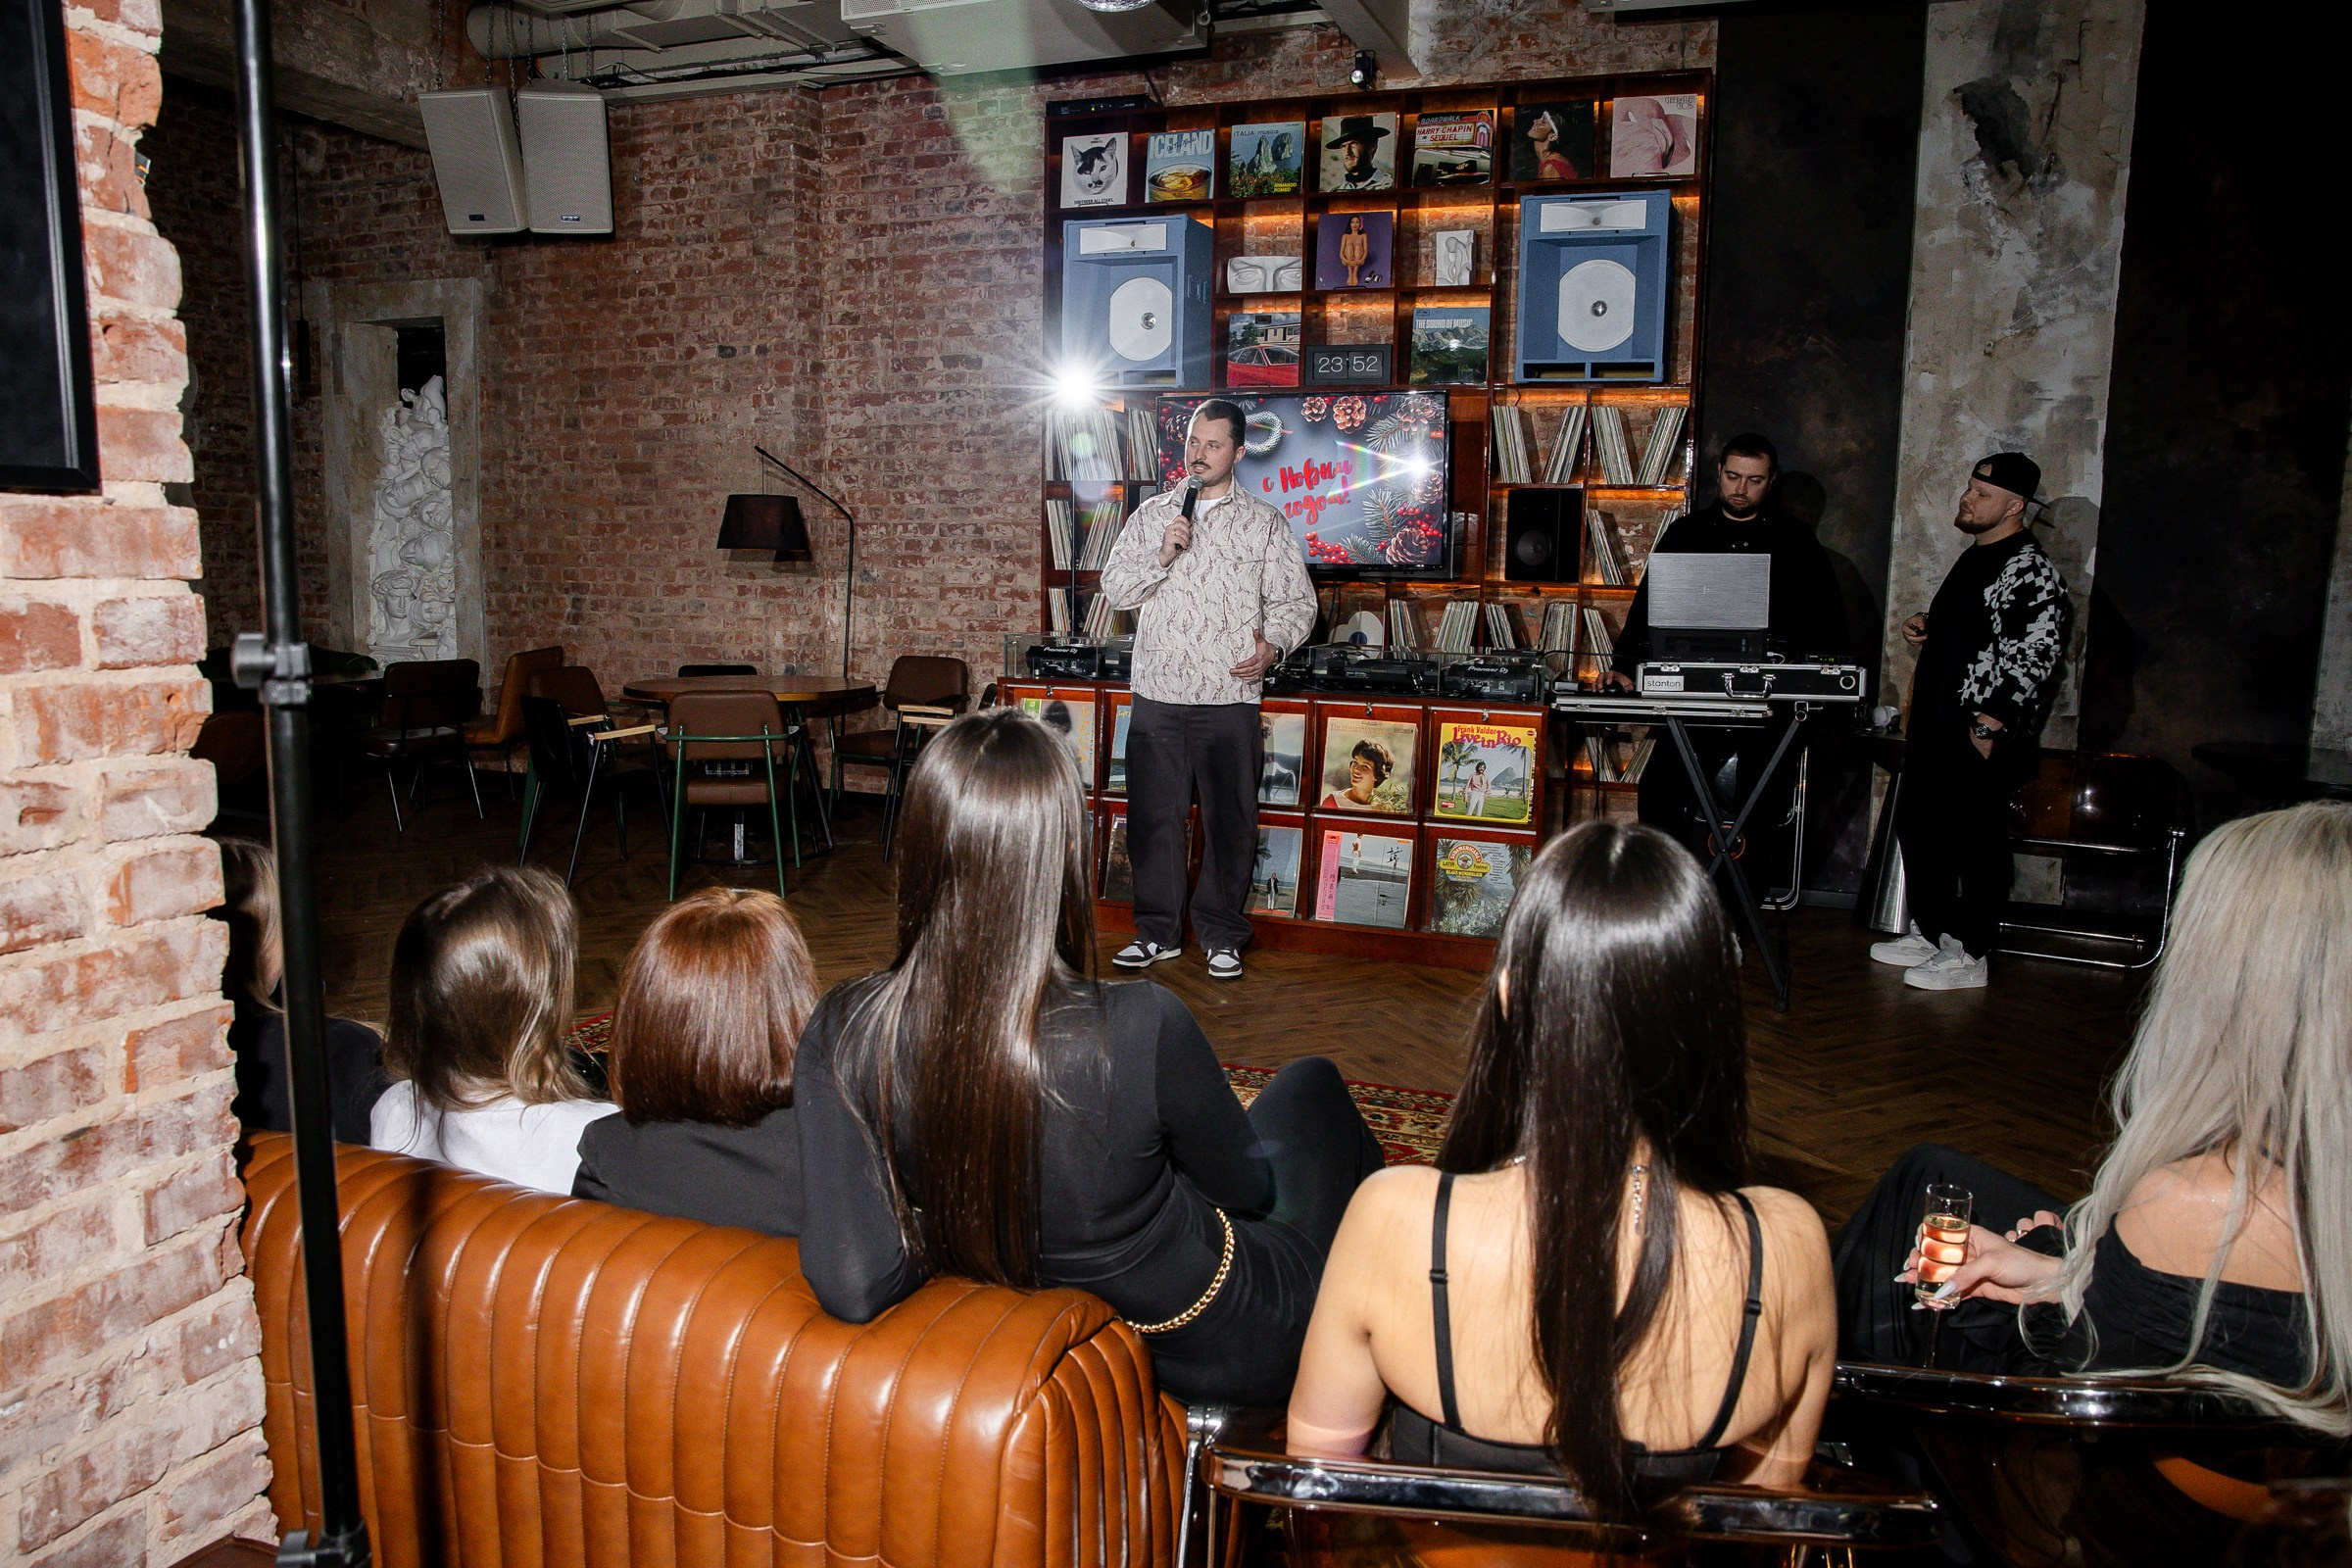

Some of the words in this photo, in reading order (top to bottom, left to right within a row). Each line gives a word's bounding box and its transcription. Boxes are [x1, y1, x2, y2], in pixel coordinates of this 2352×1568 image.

[1421, 115, 1461, 124] BOARDWALK
[1441, 124, 1473, 134] CHAPIN
[1149, 130, 1214, 159] ICELAND
[1416, 318, 1426, 328] THE
[1426, 318, 1446, 328] SOUND
[1446, 318, 1453, 328] OF
[1453, 318, 1473, 328] MUSIC
[1279, 458, 1351, 493] Новым
[1457, 725, 1474, 734] Frank
[1452, 726, 1480, 743] Live
[1481, 737, 1496, 748] in
[1495, 729, 1521, 746] Rio
